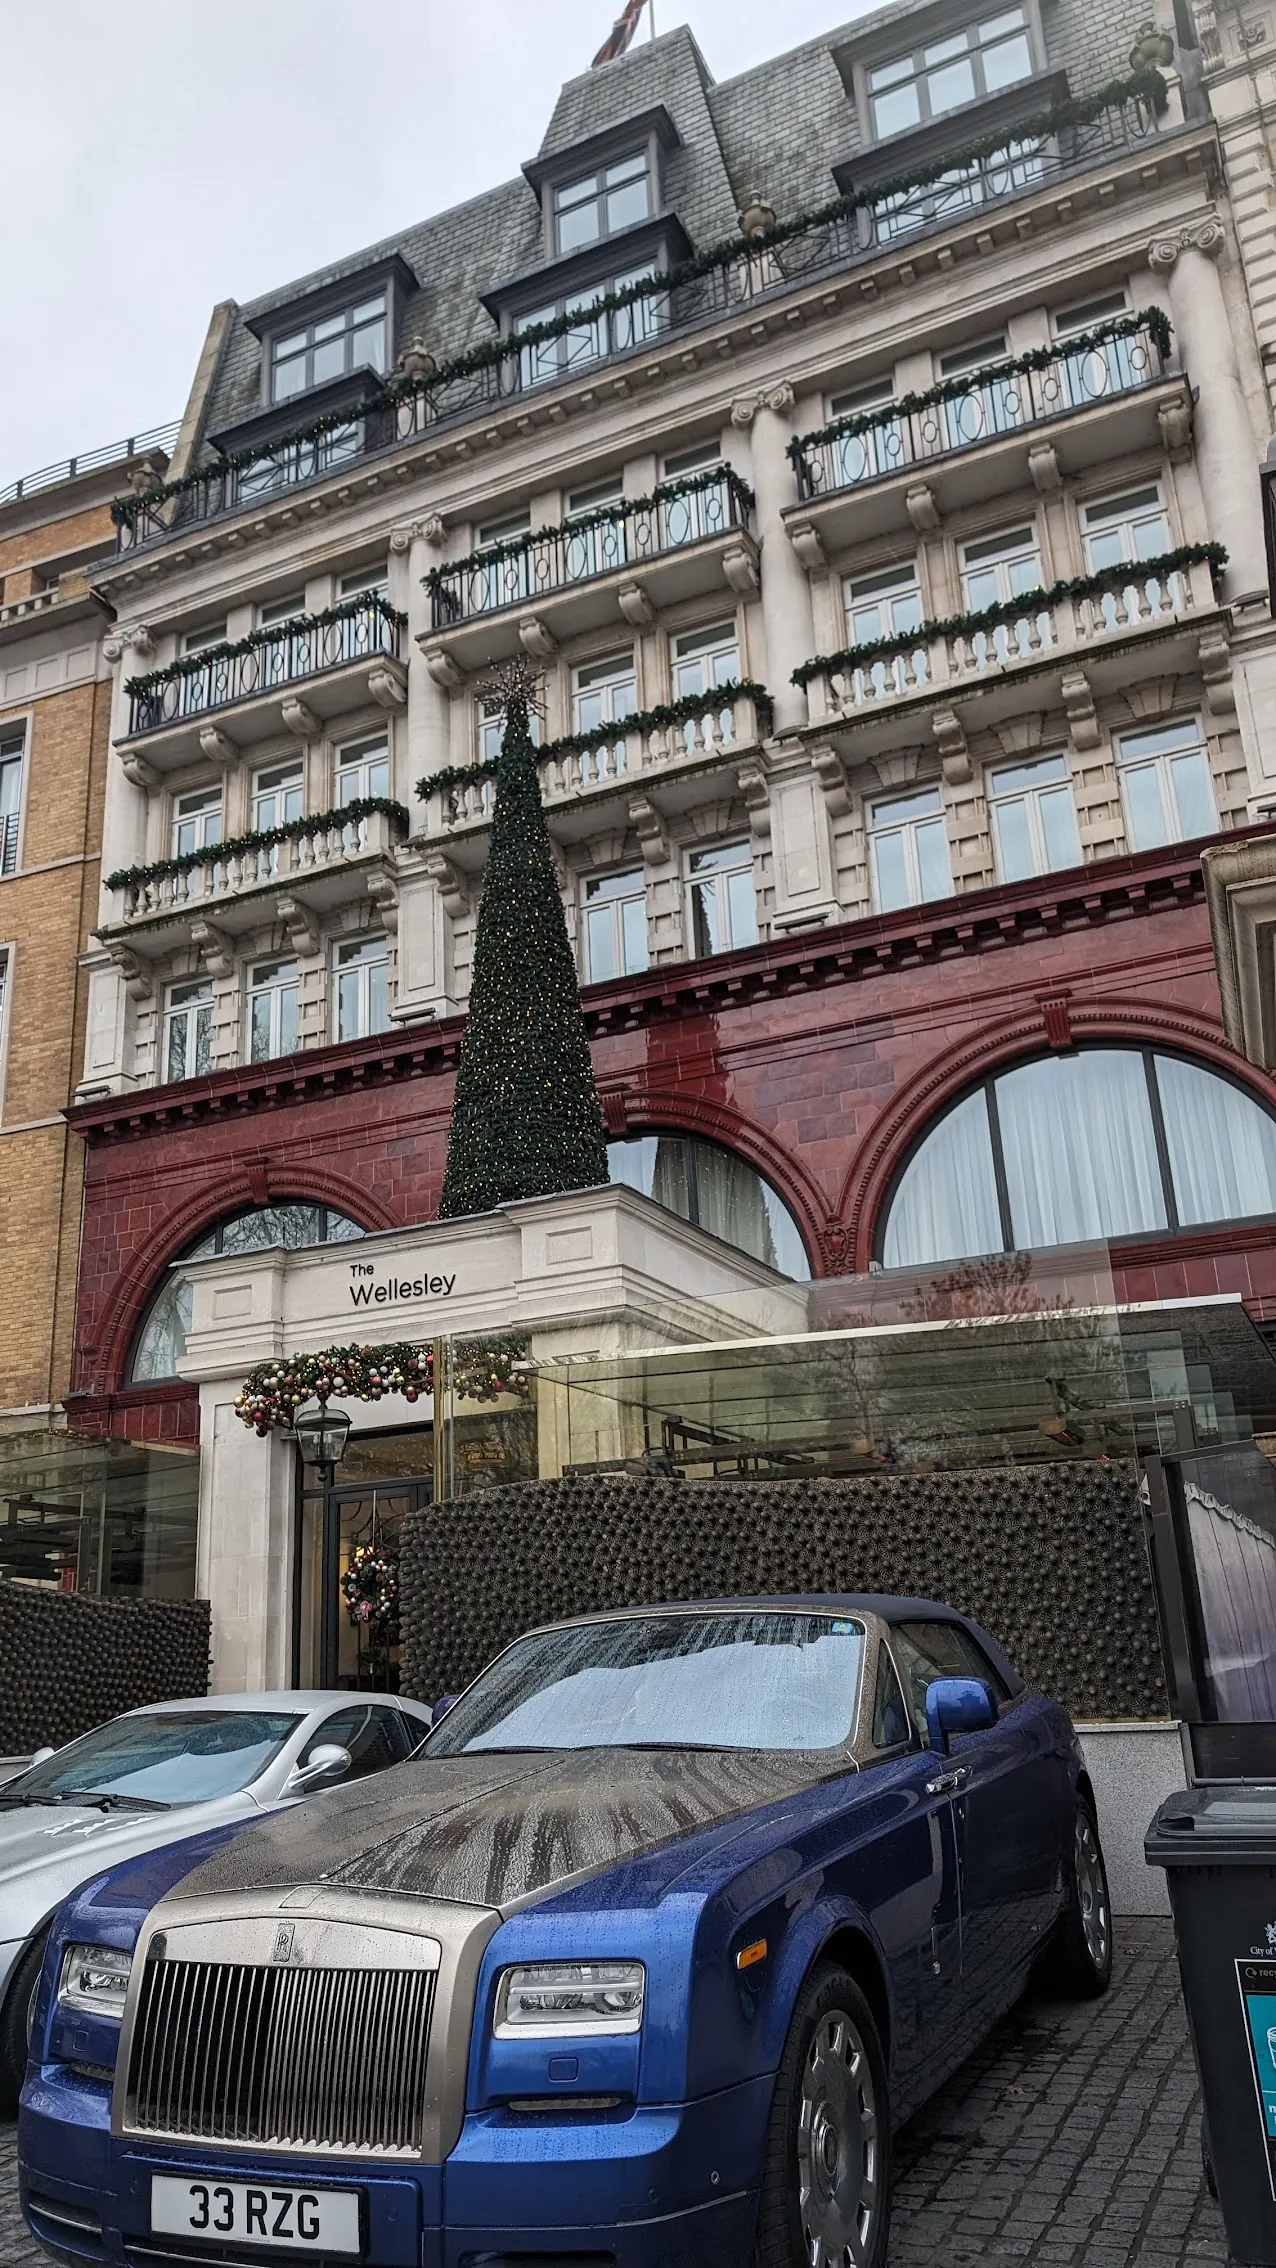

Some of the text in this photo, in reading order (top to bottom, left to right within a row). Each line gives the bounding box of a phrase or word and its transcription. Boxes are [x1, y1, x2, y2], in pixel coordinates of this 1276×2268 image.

[349, 1263, 375, 1278] The
[349, 1273, 456, 1306] Wellesley
[1250, 1946, 1265, 1957] City
[1265, 1946, 1274, 1956] of
[189, 2184, 321, 2241] 33 RZG
